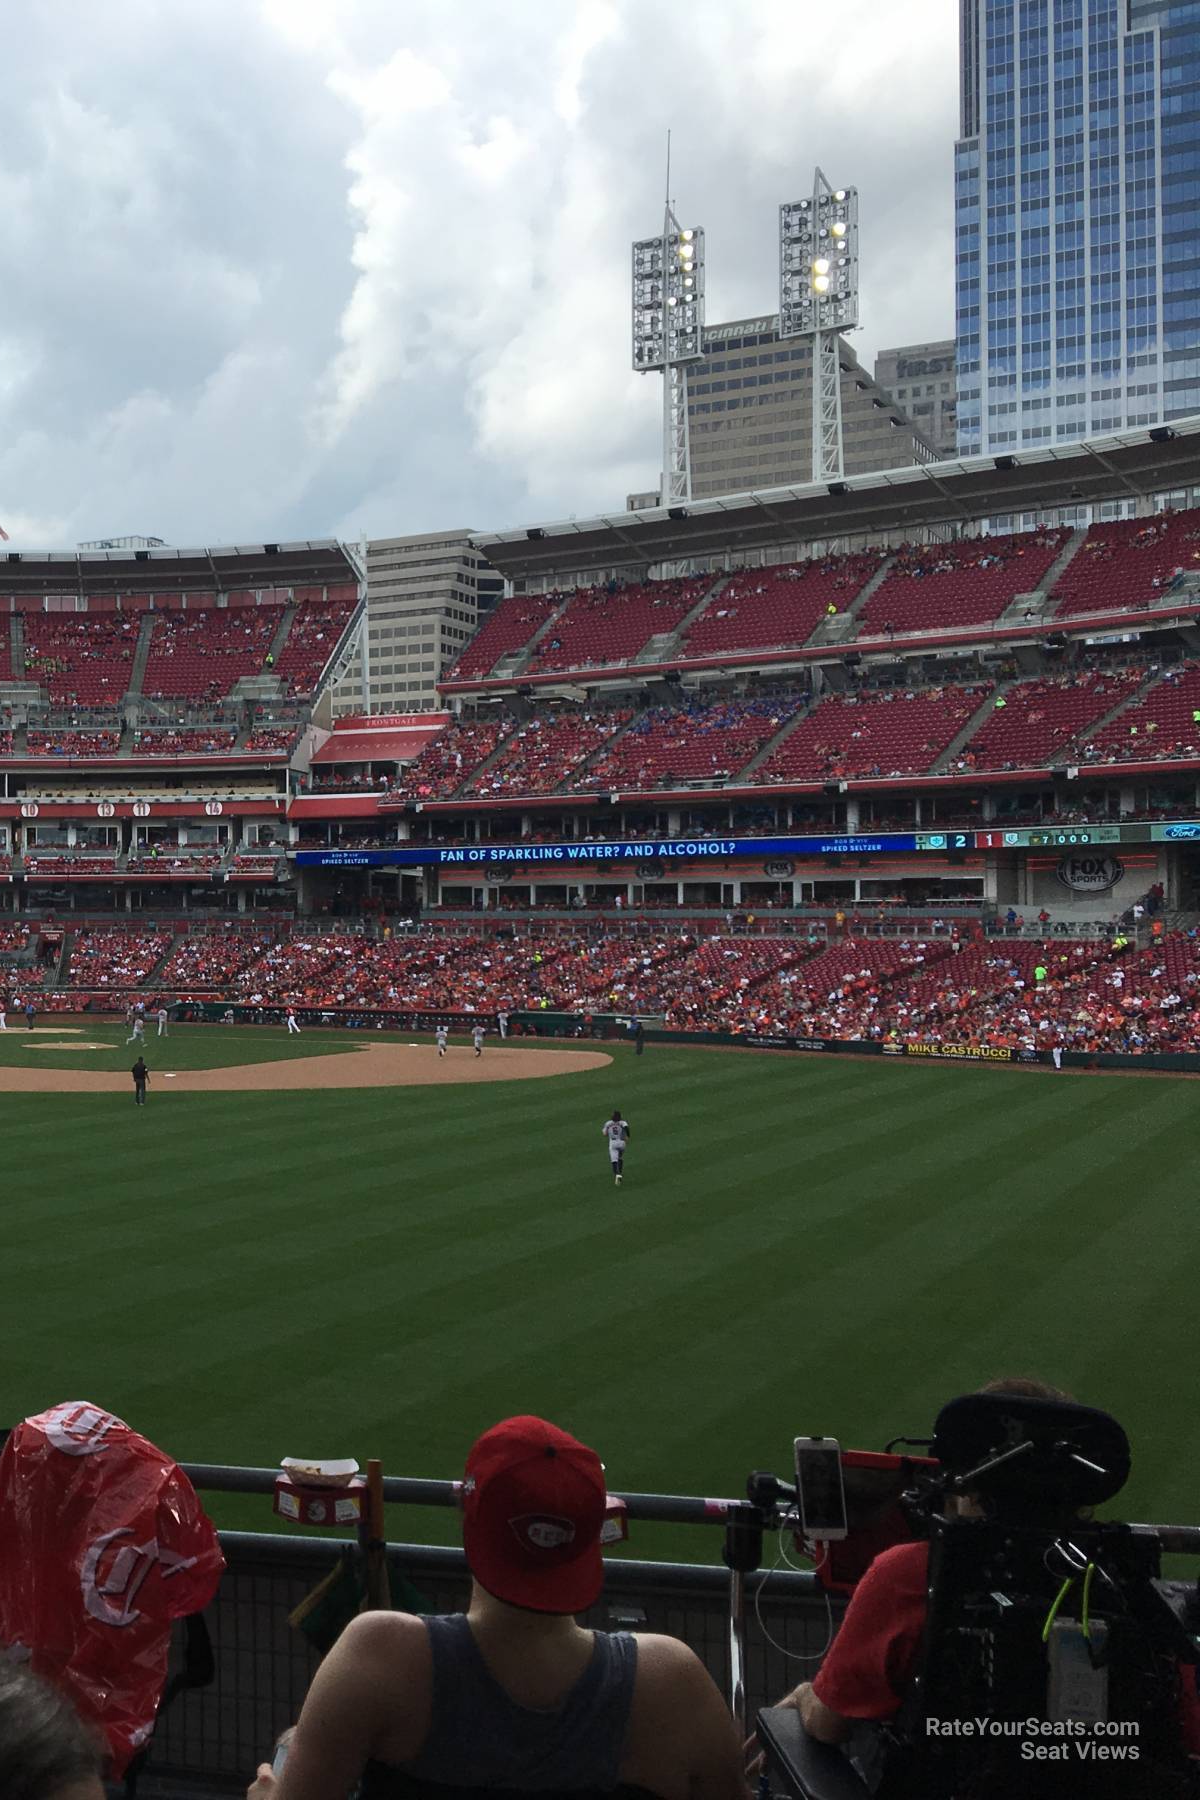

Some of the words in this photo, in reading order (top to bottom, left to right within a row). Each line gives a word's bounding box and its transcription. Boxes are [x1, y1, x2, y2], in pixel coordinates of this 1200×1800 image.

[24, 804, 36, 816] 10
[100, 804, 112, 816] 13
[136, 804, 146, 816] 11
[1169, 827, 1196, 838] Ford
[955, 835, 966, 847] 2
[987, 834, 993, 846] 1
[1042, 836, 1049, 844] 7
[1058, 835, 1066, 844] 0
[1069, 834, 1077, 843] 0
[1081, 834, 1089, 843] 0
[440, 851, 463, 861] FAN
[469, 850, 486, 861] OF
[491, 848, 564, 860] SPARKLING
[567, 846, 619, 858] WATER?
[624, 845, 654, 857] AND
[658, 843, 735, 856] ALCOHOL?
[1070, 858, 1107, 875] FOX
[1071, 875, 1109, 883] SPORTS
[908, 1043, 939, 1053] MIKE
[941, 1045, 1012, 1058] CASTRUCCI
